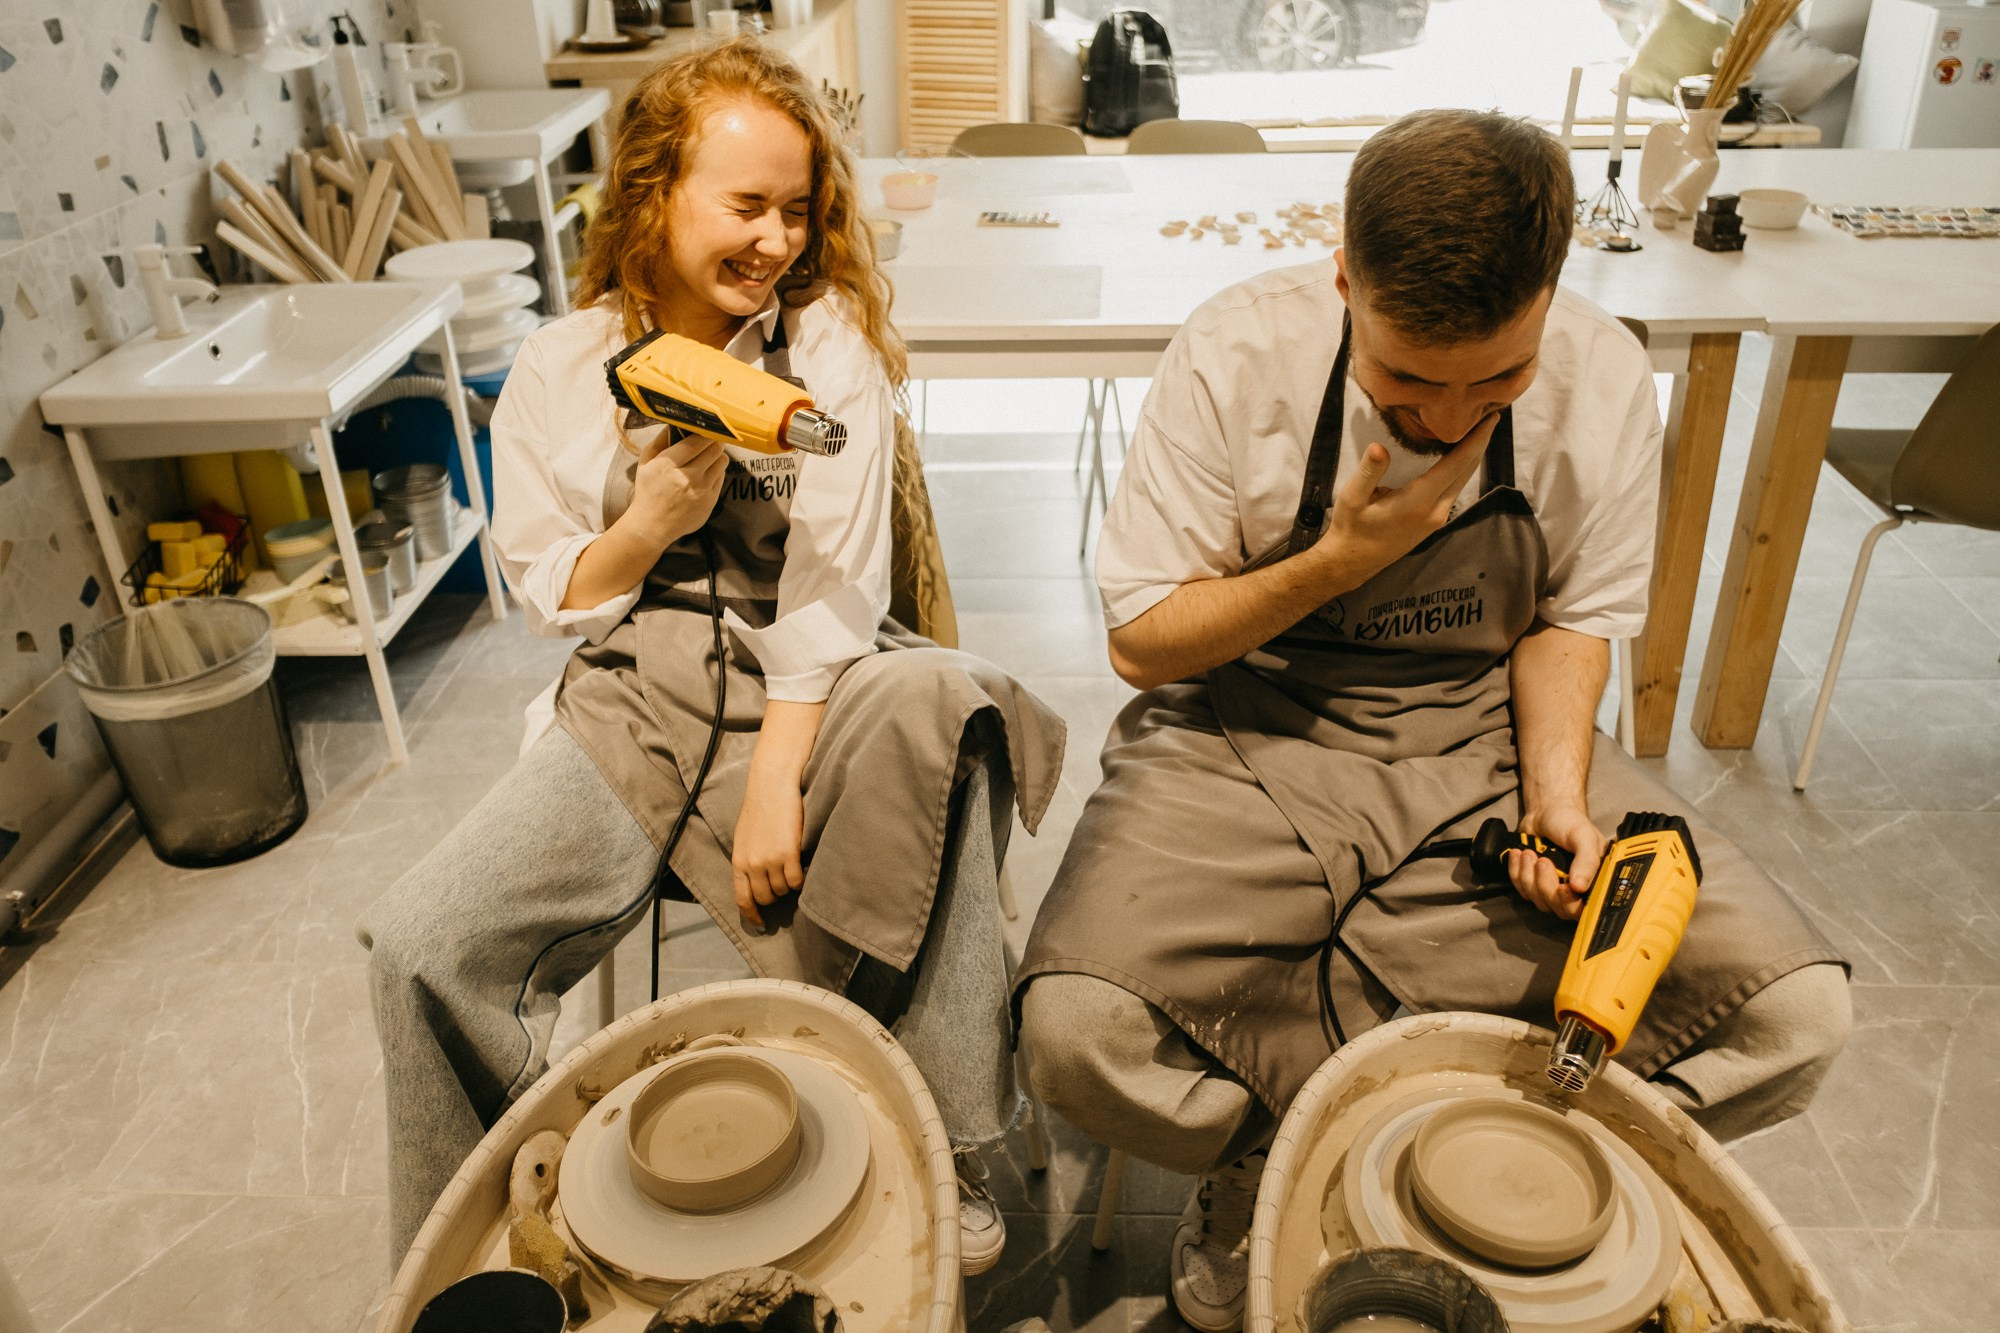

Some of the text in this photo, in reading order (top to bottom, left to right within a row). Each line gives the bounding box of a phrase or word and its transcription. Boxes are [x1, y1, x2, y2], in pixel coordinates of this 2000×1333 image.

[721, 473, 797, 503] ЛИБИ
[1353, 599, 1483, 641] КУЛИБИН
[1367, 586, 1475, 620] ГОНЧАРНАЯ МАСТЕРСКАЯ
